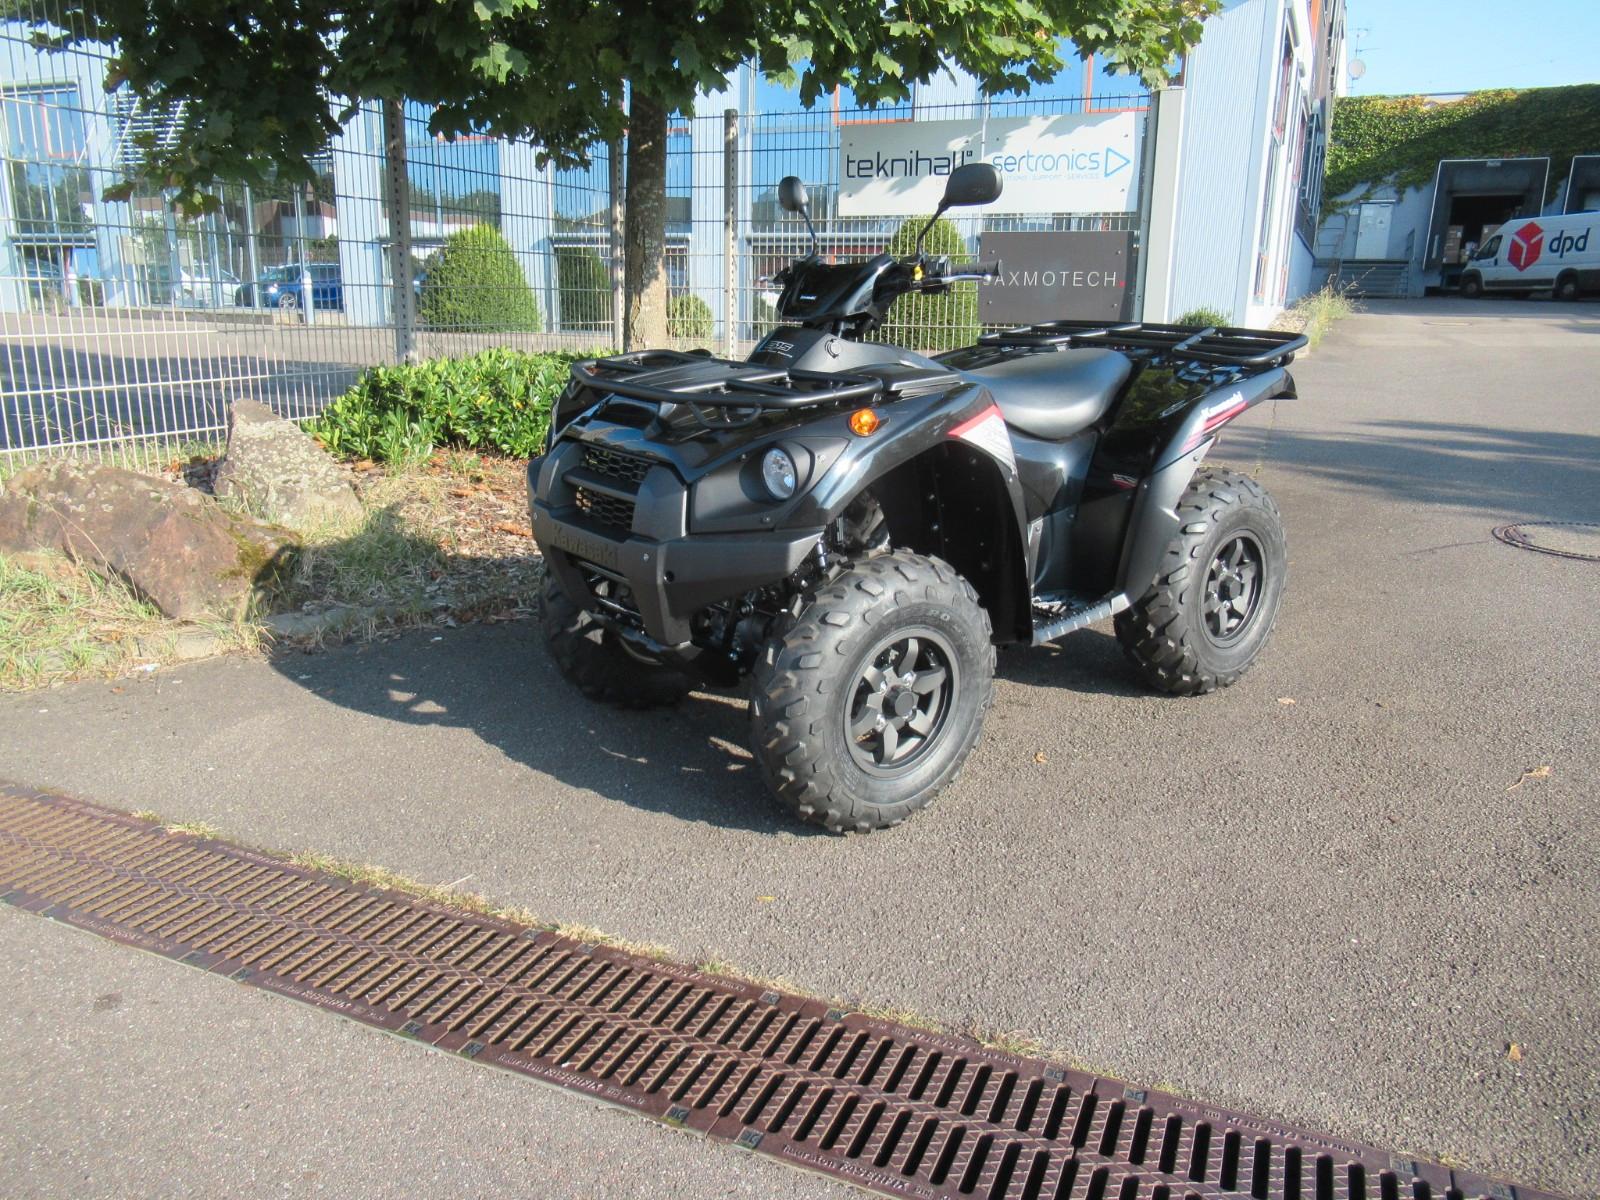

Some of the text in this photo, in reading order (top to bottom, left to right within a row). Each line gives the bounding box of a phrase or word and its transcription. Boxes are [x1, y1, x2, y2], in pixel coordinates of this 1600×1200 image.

[846, 150, 965, 178] teknihall
[992, 148, 1100, 173] sertronics
[1548, 227, 1592, 259] dpd
